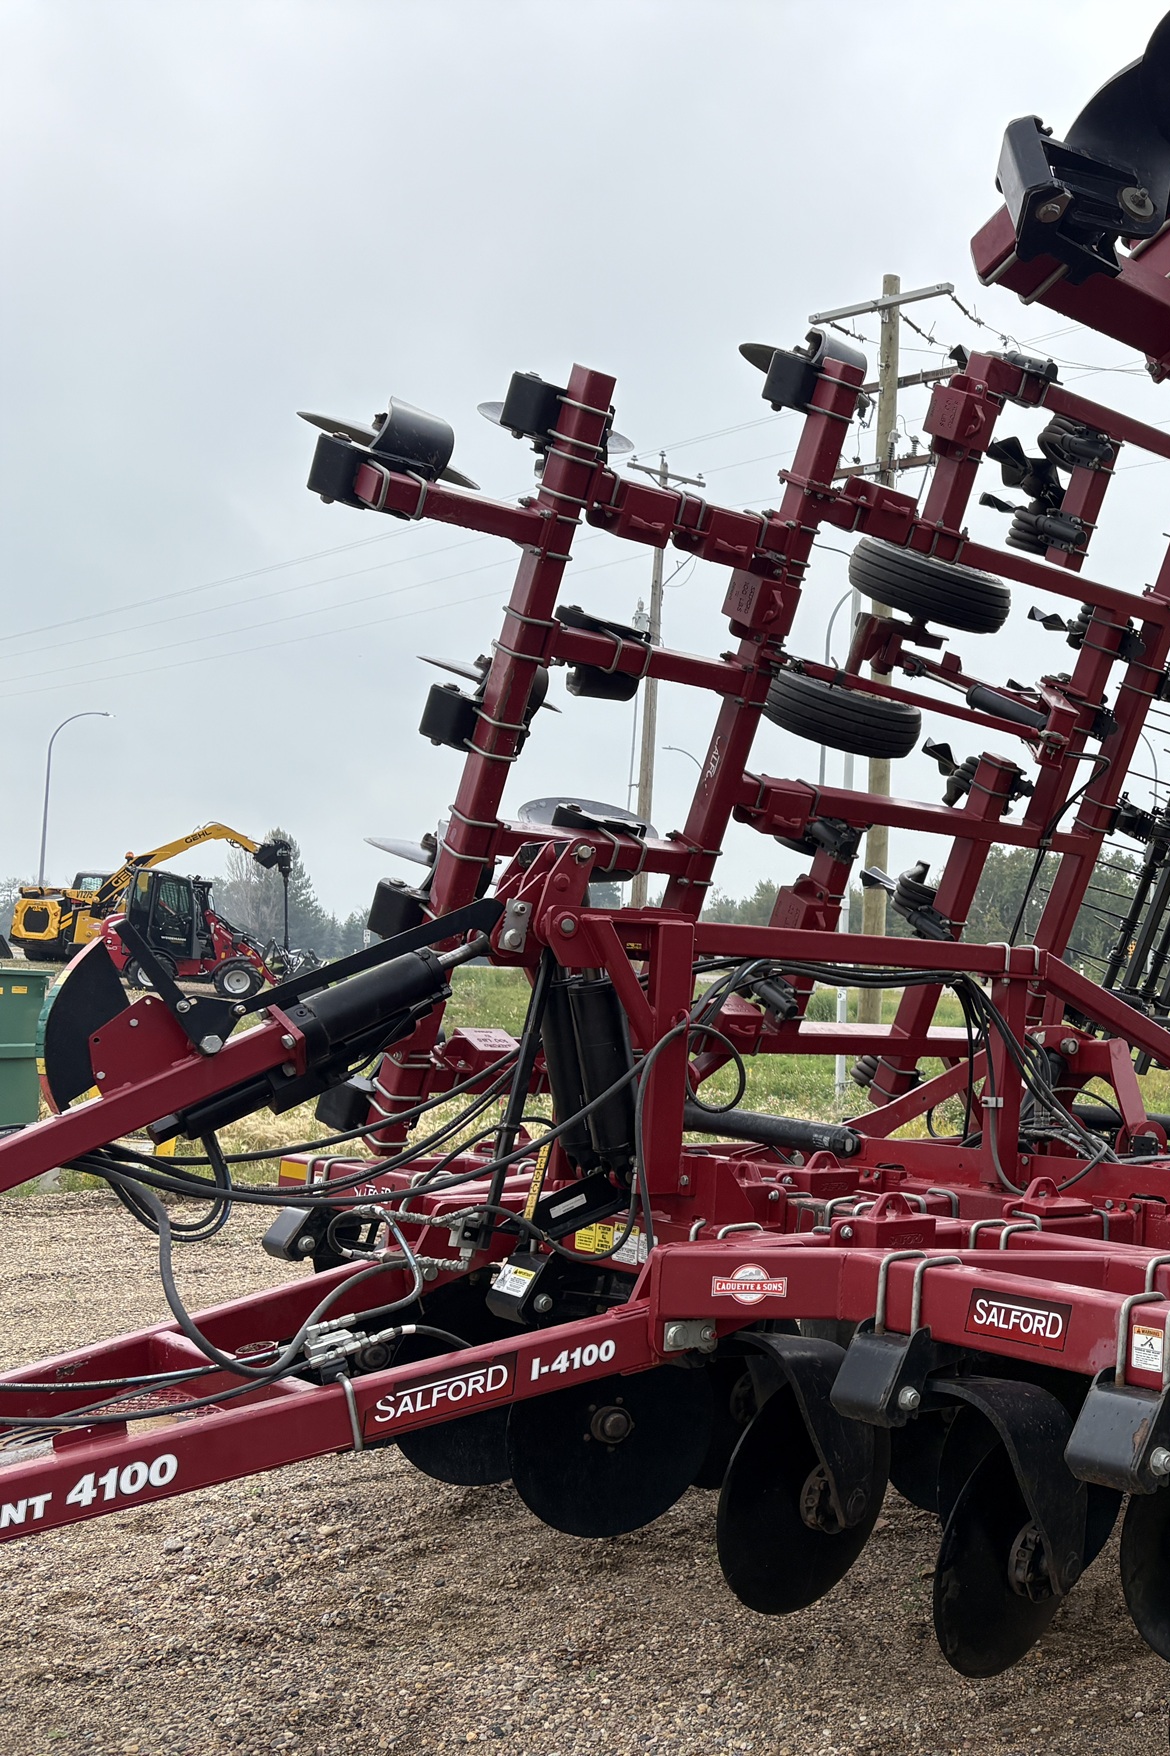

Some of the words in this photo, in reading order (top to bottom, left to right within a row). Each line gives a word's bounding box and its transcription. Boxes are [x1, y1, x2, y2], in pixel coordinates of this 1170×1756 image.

[184, 829, 212, 843] GEHL
[531, 1183, 538, 1193] C
[716, 1282, 756, 1291] CAOUETTE
[763, 1283, 783, 1291] SONS
[973, 1298, 1063, 1340] SALFORD
[373, 1364, 508, 1423] SALFORD
[530, 1339, 616, 1381] I-4100
[65, 1453, 179, 1508] 4100
